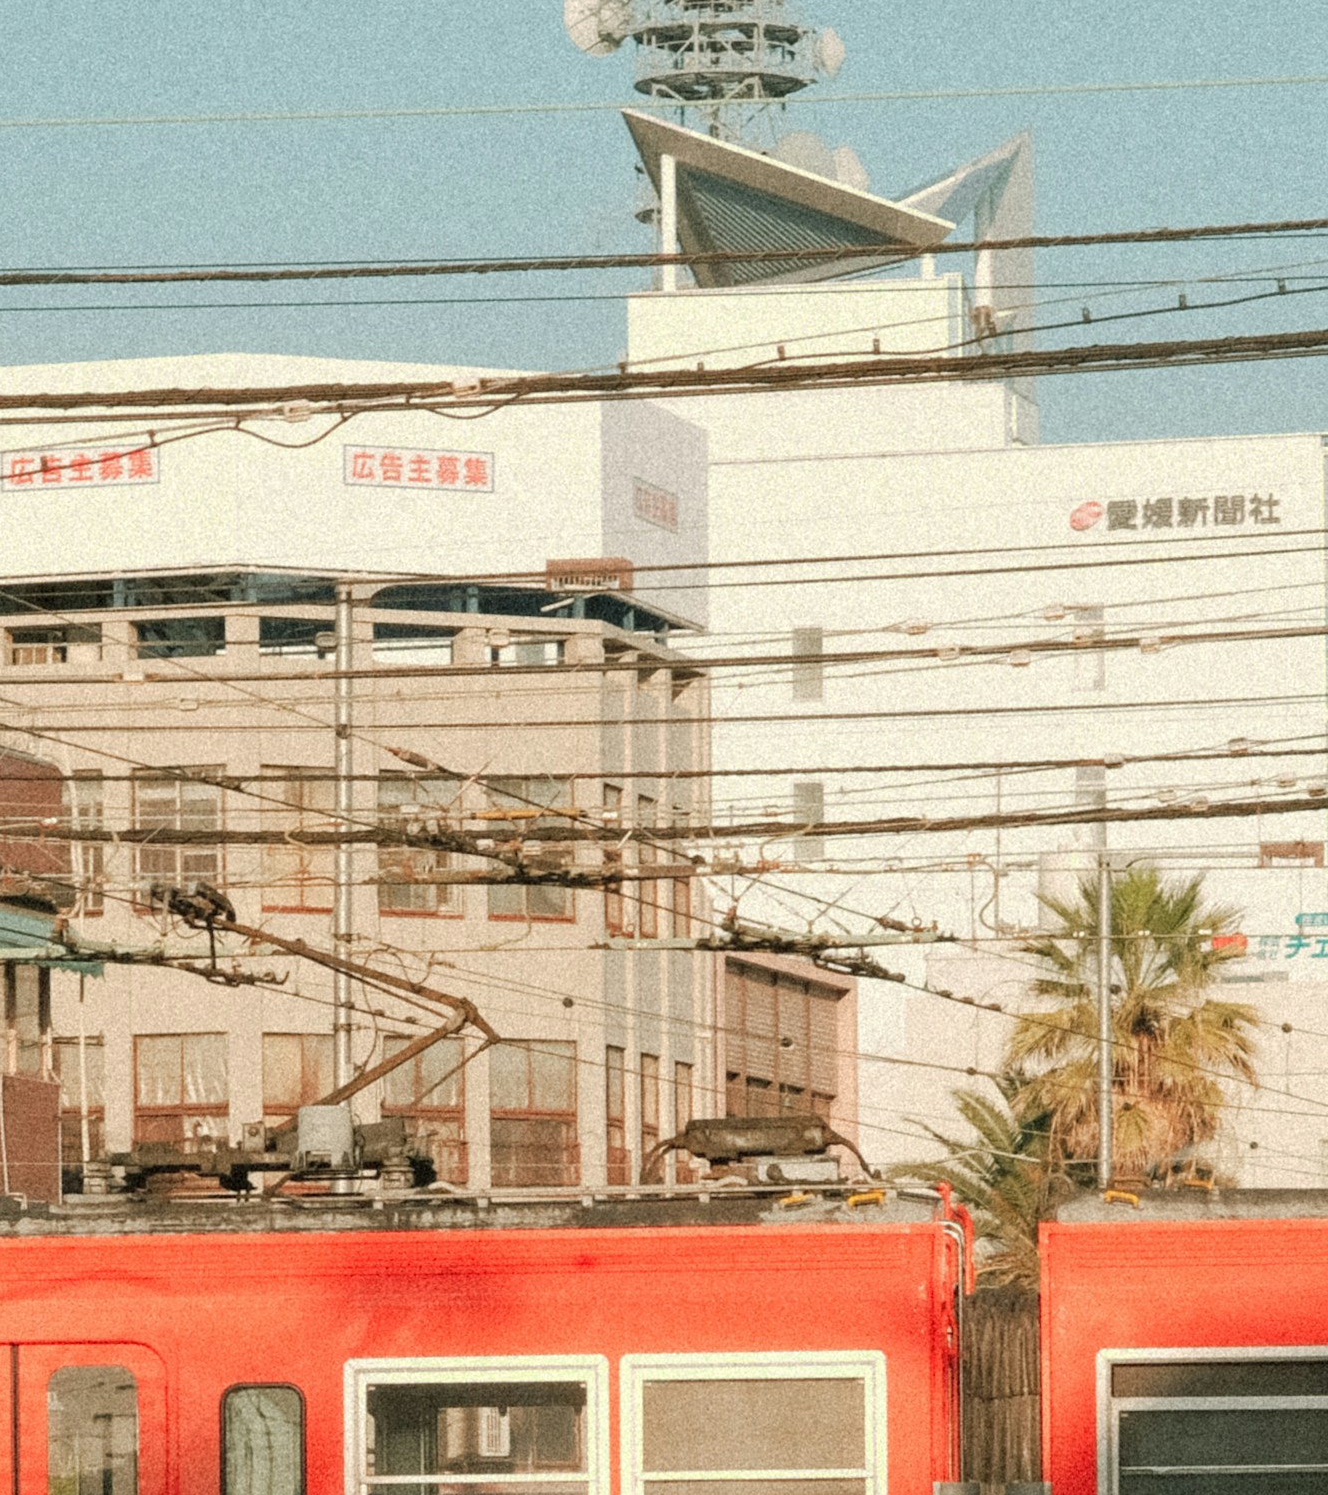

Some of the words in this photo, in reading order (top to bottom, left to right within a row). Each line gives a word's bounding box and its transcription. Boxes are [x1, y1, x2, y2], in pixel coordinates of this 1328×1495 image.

[9, 450, 153, 485] 広告主募集
[352, 450, 488, 486] 広告主募集
[1106, 492, 1281, 531] 愛媛新聞社
